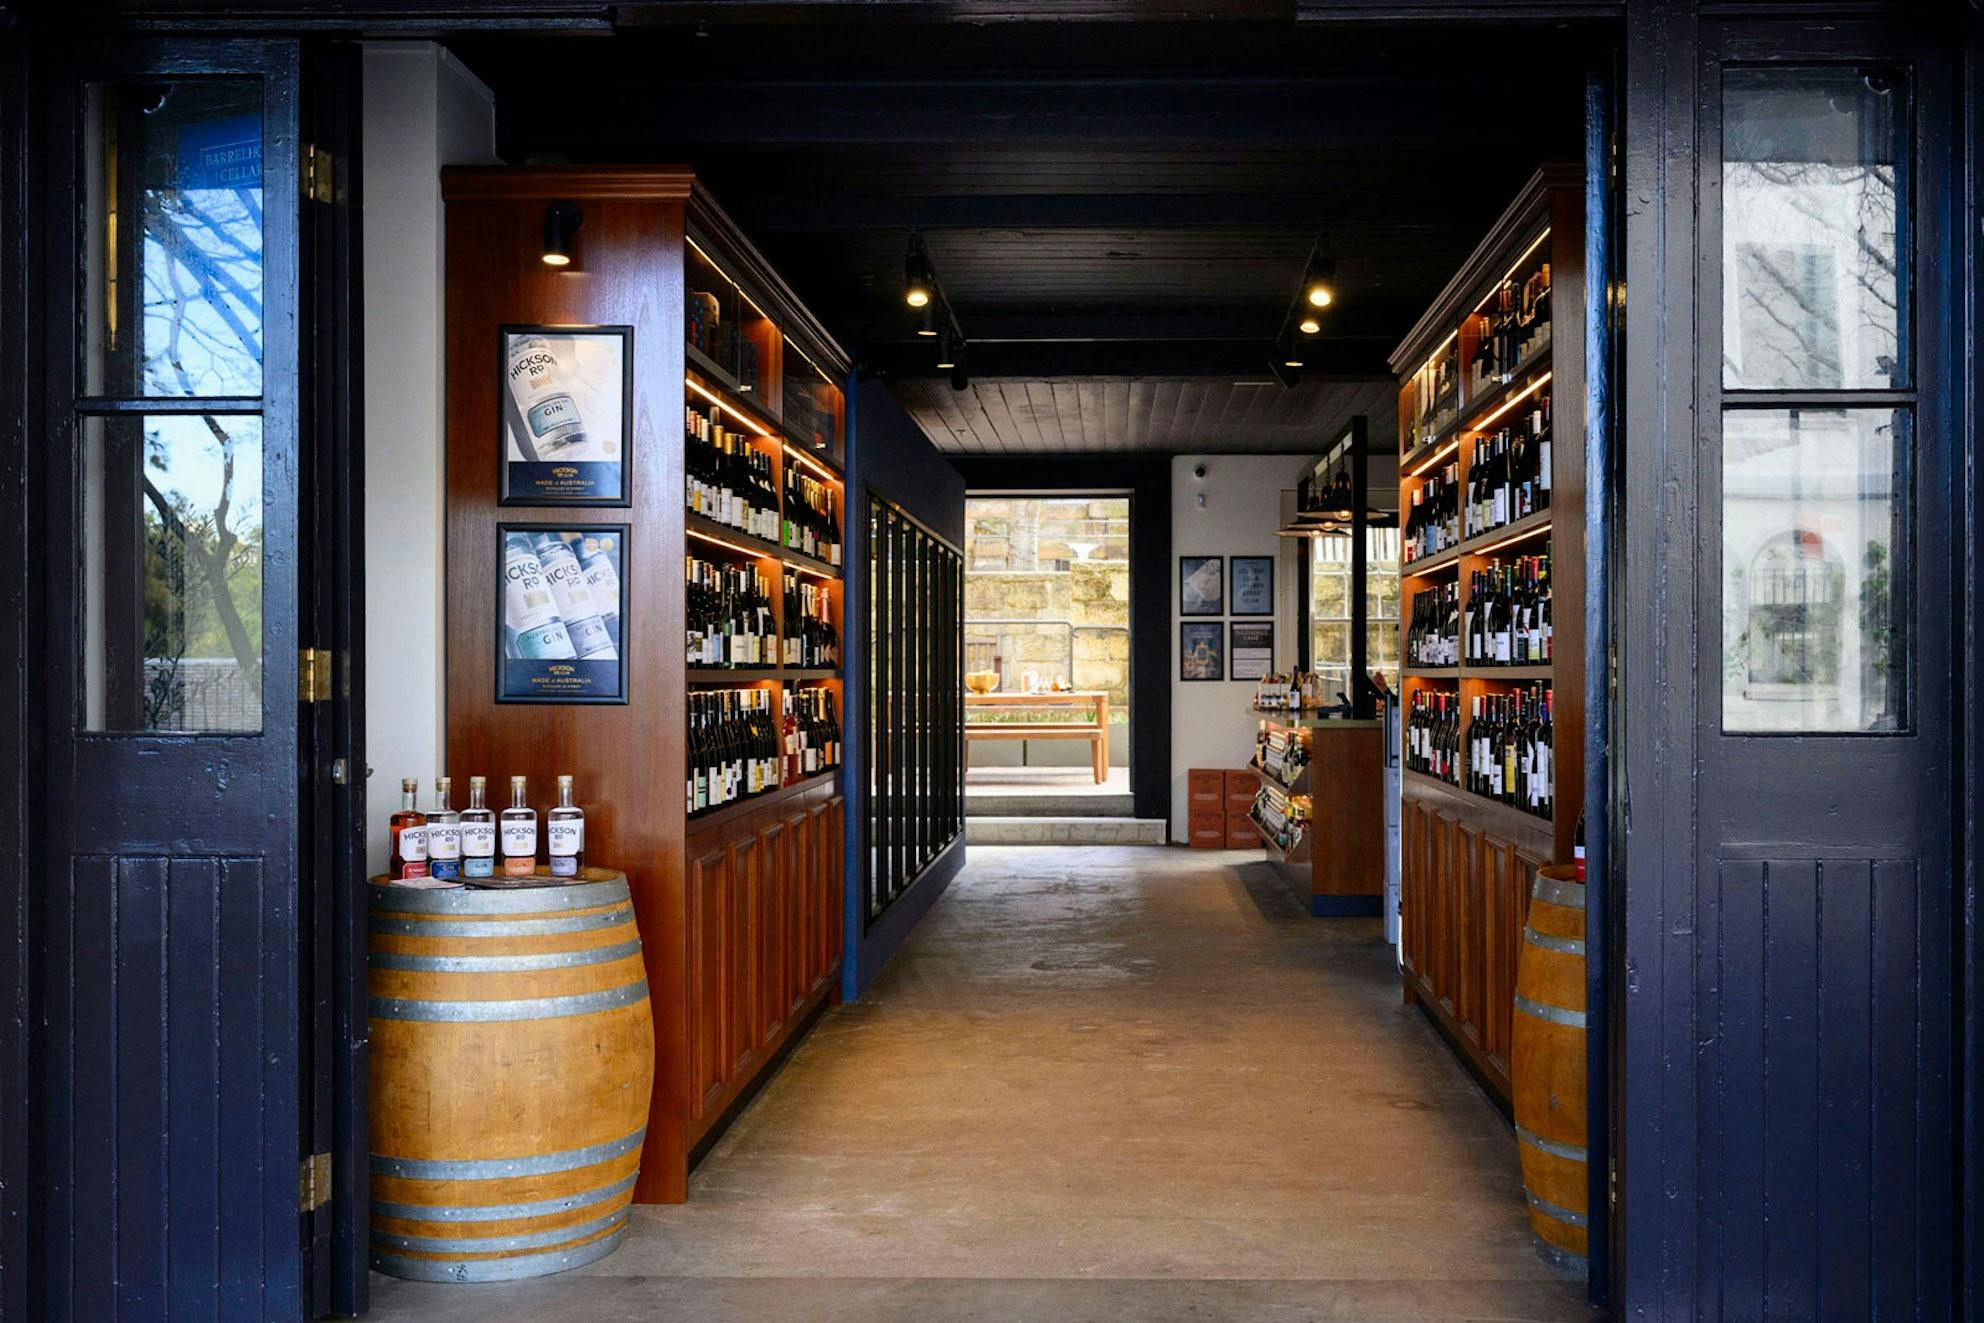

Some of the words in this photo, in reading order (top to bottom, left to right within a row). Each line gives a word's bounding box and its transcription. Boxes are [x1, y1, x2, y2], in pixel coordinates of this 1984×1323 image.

[510, 353, 558, 380] HICKSON
[529, 364, 544, 376] RD
[544, 403, 564, 416] GIN
